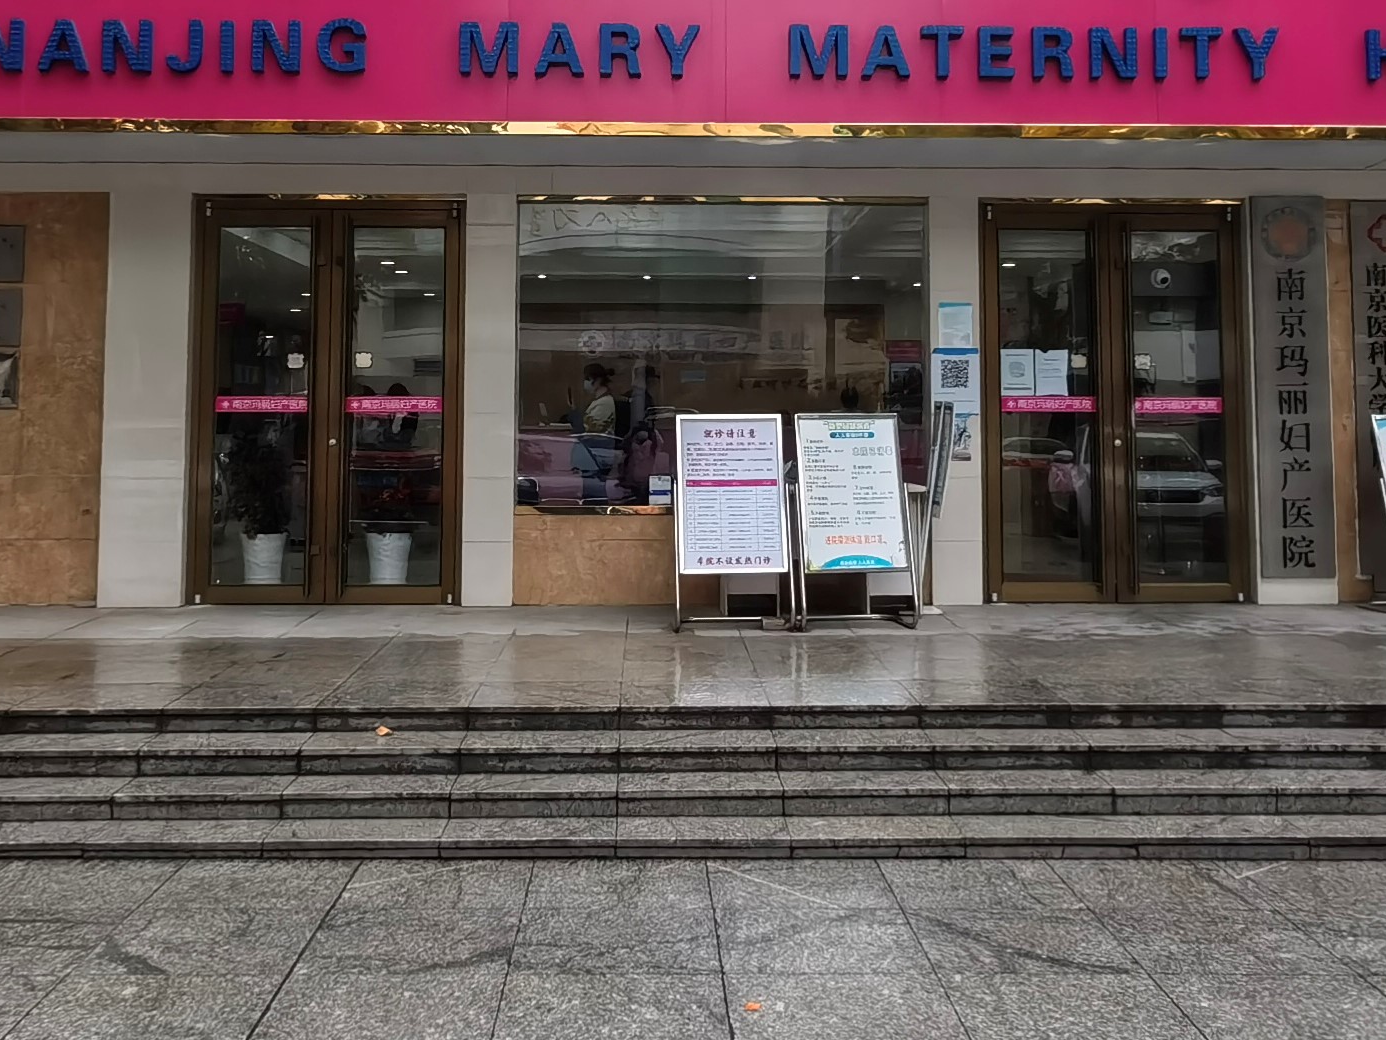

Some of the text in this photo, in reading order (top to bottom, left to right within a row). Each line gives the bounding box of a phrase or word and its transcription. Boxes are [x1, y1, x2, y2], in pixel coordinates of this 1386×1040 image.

[458, 21, 702, 79] MARY
[787, 22, 1281, 83] MATERNITY
[1274, 267, 1317, 569] 南京玛丽妇产医院
